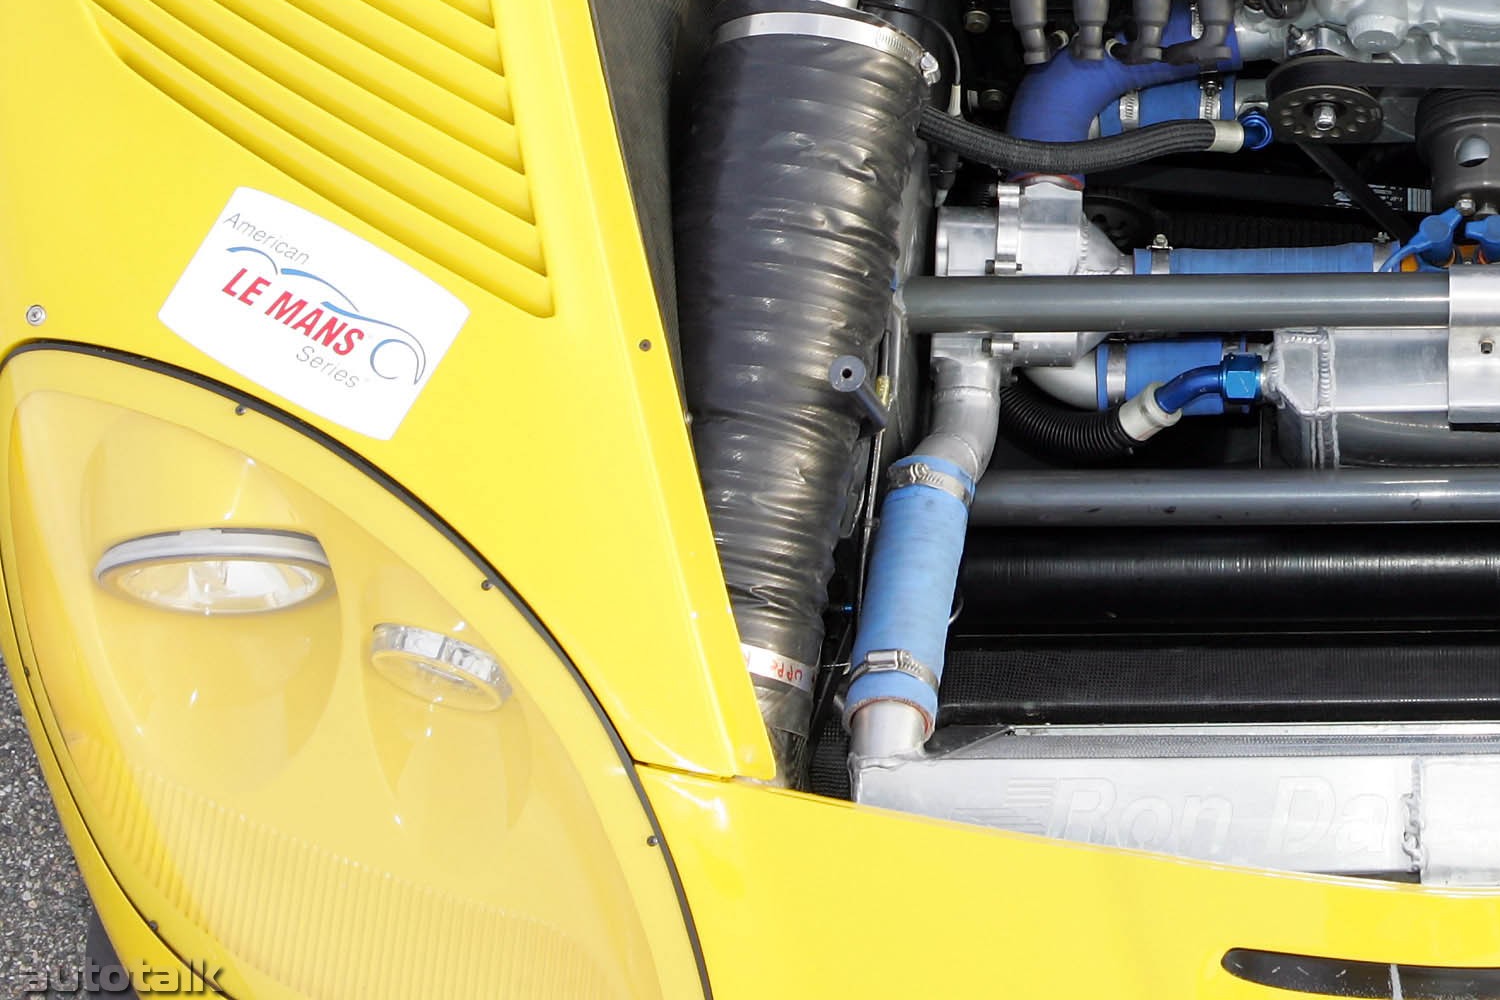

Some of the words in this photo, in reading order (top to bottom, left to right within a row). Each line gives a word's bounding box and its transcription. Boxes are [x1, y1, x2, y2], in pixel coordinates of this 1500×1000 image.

[223, 211, 311, 266] American
[221, 267, 272, 306] LE
[264, 290, 365, 357] MANS
[295, 344, 360, 390] Series
[1047, 775, 1234, 852] Ron
[1266, 775, 1392, 855] Da
